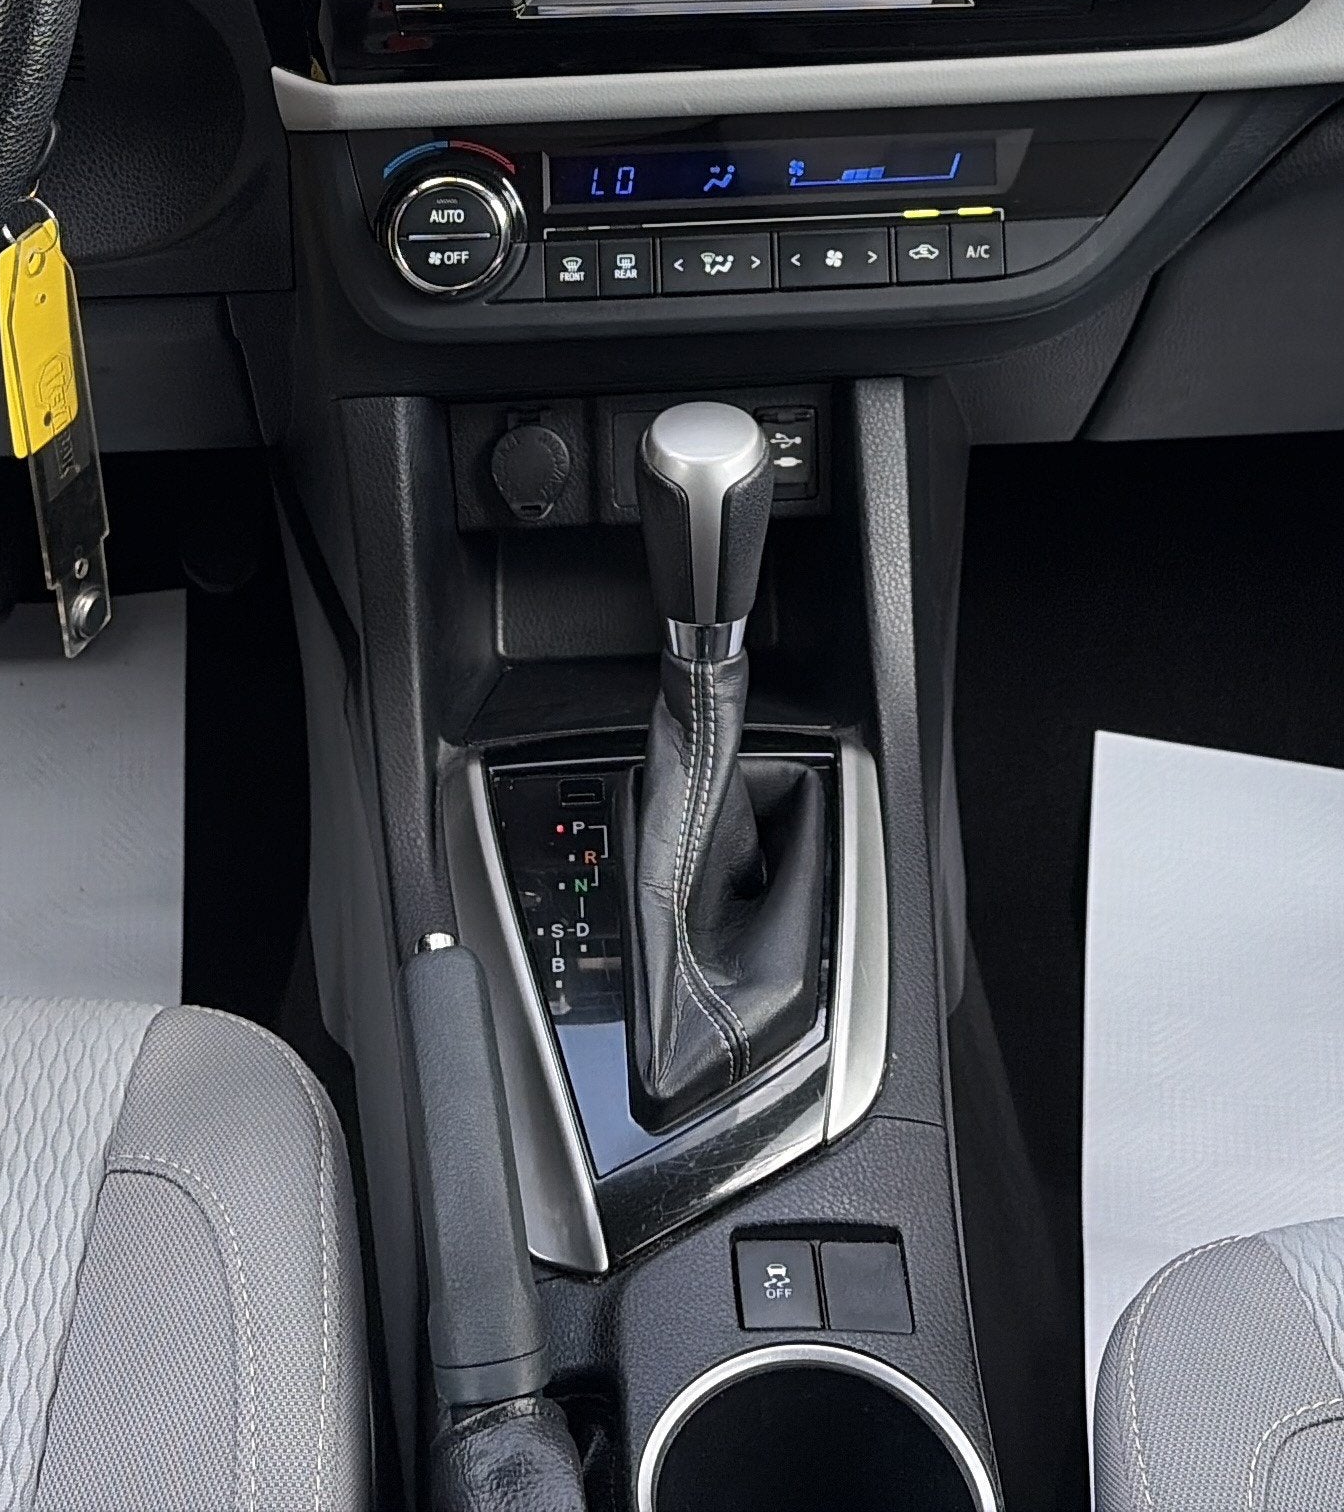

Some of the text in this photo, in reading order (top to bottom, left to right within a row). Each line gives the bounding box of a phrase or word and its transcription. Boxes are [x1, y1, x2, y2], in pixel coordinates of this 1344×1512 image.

[430, 210, 465, 224] AUTO
[444, 252, 469, 265] OFF
[967, 245, 990, 259] A/C
[560, 272, 584, 282] FRONT
[615, 269, 638, 279] REAR
[573, 822, 586, 835] P
[585, 851, 598, 864] R
[575, 879, 588, 892] N
[552, 924, 565, 938] S
[577, 923, 590, 937] D
[552, 958, 566, 973] B
[766, 1289, 793, 1299] OFF
